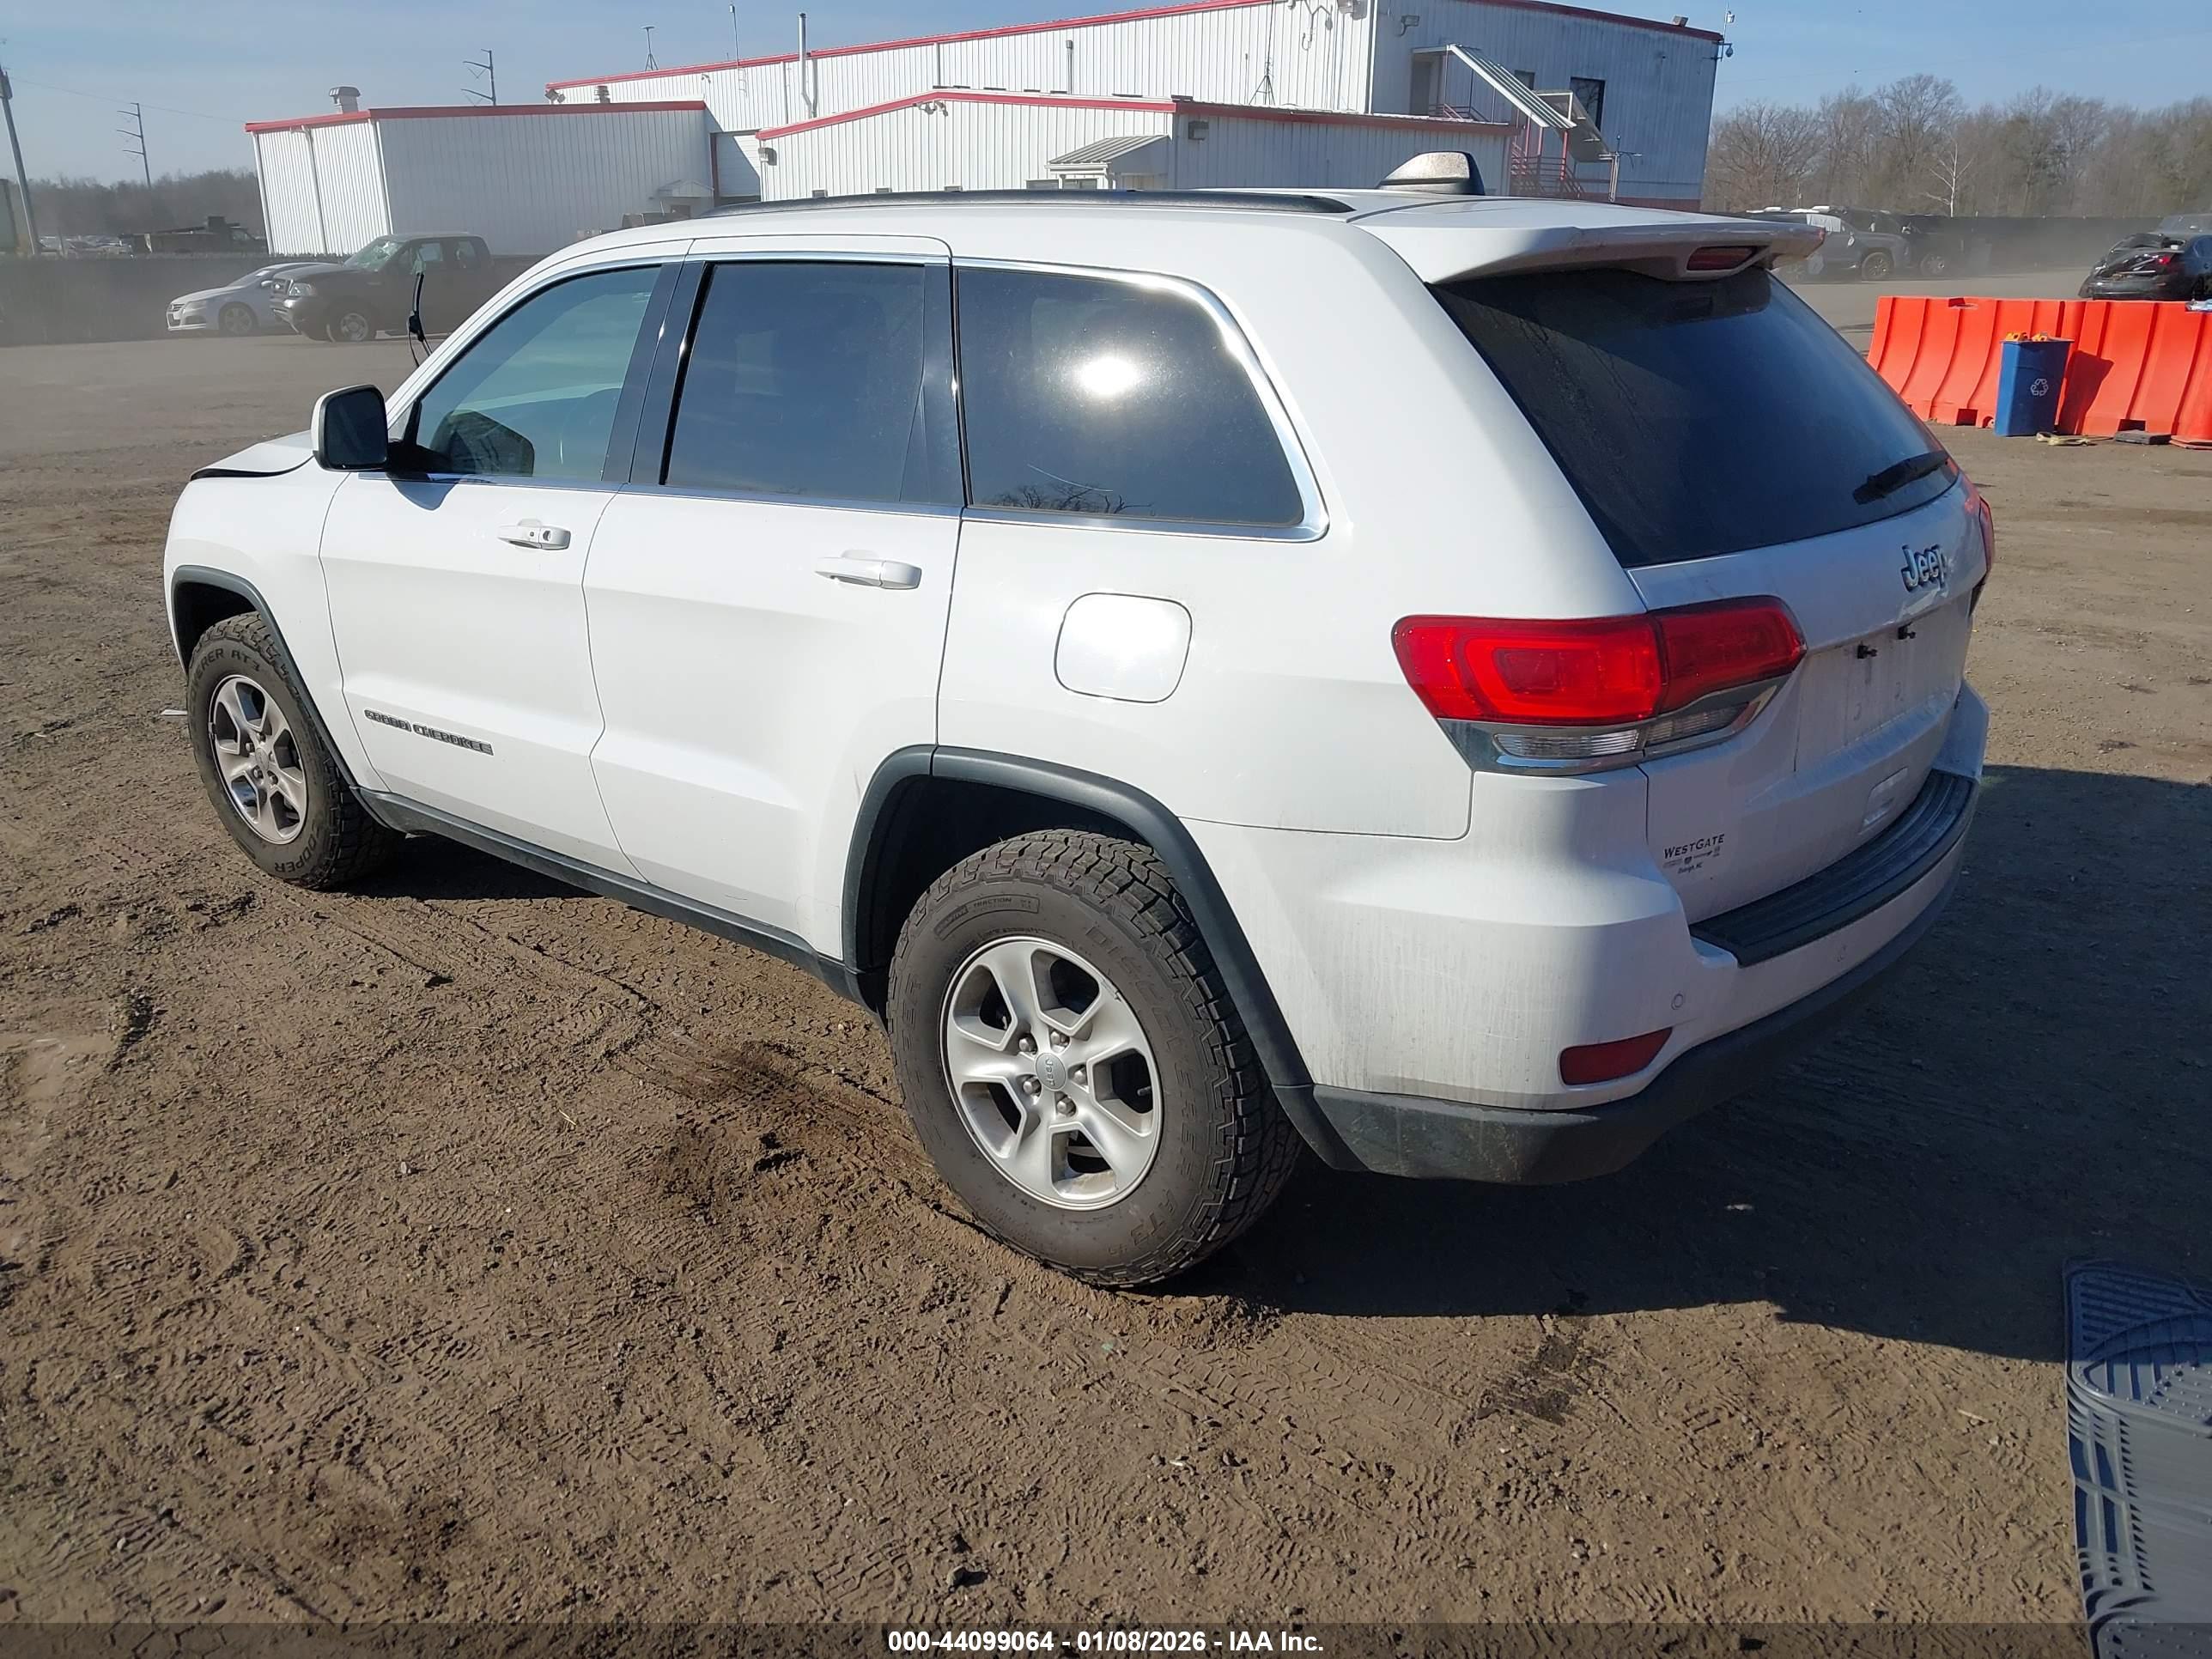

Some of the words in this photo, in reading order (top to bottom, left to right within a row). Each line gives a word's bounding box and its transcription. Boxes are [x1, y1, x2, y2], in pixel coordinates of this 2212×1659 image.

[1900, 544, 1947, 594] Jeep
[364, 709, 412, 732] GRAND
[412, 724, 494, 756] CHEROKEE
